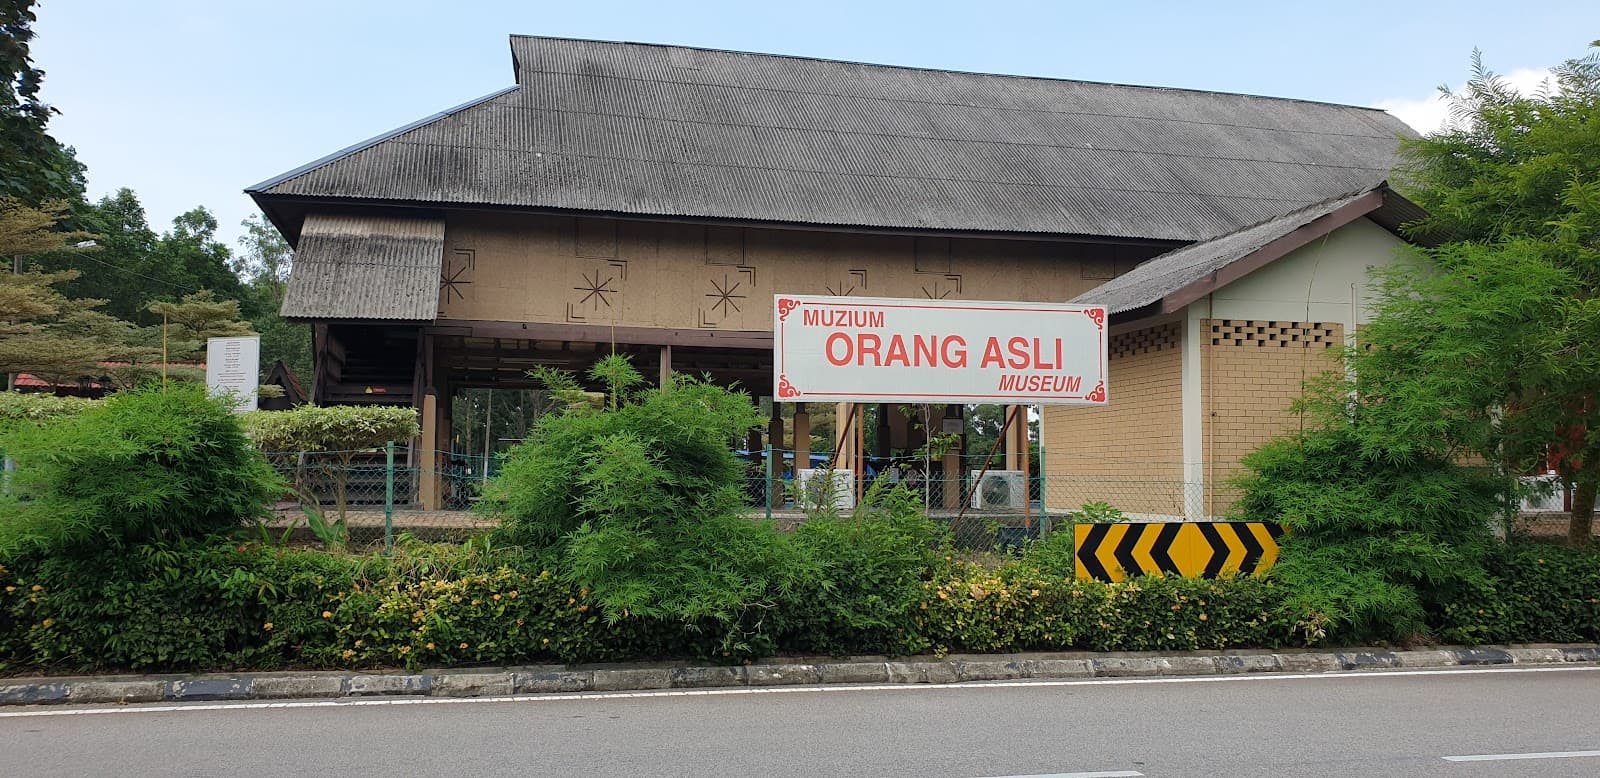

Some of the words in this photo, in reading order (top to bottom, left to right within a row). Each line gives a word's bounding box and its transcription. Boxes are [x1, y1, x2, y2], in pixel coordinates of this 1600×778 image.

[804, 310, 884, 328] MUZIUM
[826, 332, 967, 368] ORANG
[981, 336, 1062, 370] ASLI
[999, 375, 1081, 392] MUSEUM
